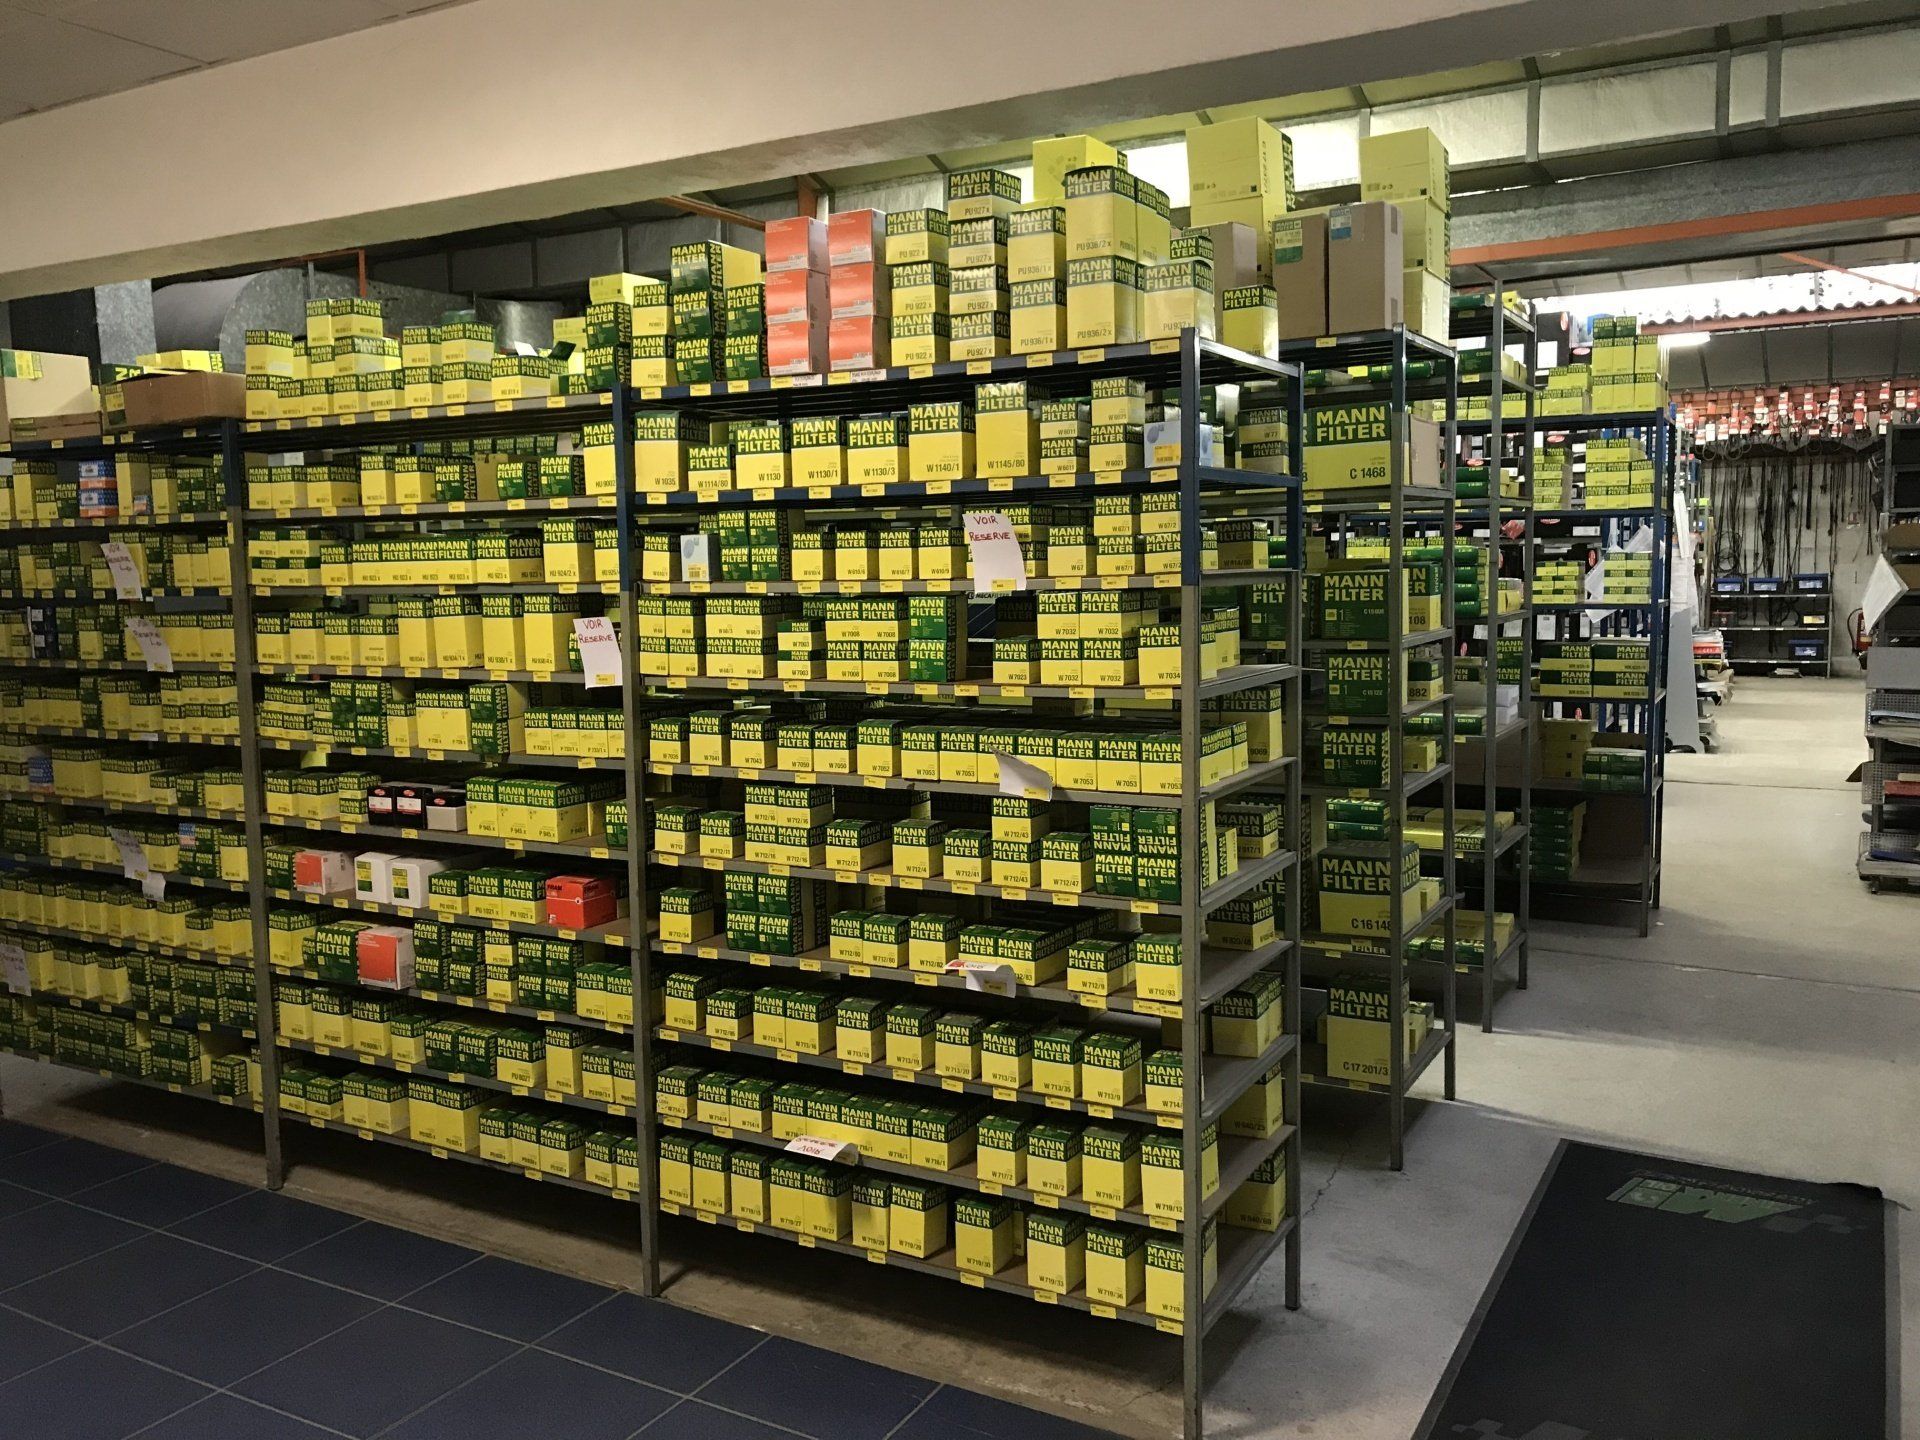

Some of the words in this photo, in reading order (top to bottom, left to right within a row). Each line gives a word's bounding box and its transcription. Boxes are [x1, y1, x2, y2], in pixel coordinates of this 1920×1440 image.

[952, 172, 990, 186] MANN
[1068, 170, 1111, 185] MANN
[952, 184, 990, 197] FILTER
[1068, 181, 1111, 196] FILTER
[672, 244, 706, 257] MANN
[672, 254, 706, 265] FILTER
[1069, 259, 1112, 274] MANN
[1146, 265, 1192, 279] MANN
[1069, 270, 1112, 284] FILTER
[1012, 282, 1054, 295] MANN
[1146, 276, 1192, 292] FILTER
[1224, 288, 1260, 299] MANN
[1012, 293, 1054, 306] FILTER
[1224, 296, 1260, 308] FILTER
[893, 316, 932, 328] MANN
[952, 314, 992, 328] MANN
[893, 324, 932, 336] FILTER
[952, 325, 992, 339] FILTER
[676, 339, 709, 351] MANN
[676, 348, 709, 360] FILTER
[978, 386, 1024, 398] MANN
[978, 398, 1024, 410] FILTER
[911, 406, 958, 419] MANN
[1316, 407, 1384, 426] MANN
[637, 418, 676, 428] MANN
[793, 421, 836, 432] MANN
[850, 422, 894, 433] MANN
[911, 418, 958, 431] FILTER
[637, 428, 676, 439] FILTER
[738, 428, 780, 440] MANN
[1317, 422, 1385, 442] FILTER
[793, 432, 836, 445] FILTER
[850, 433, 894, 446] FILTER
[738, 440, 780, 452] FILTER
[690, 447, 727, 457] MANN
[690, 457, 727, 468] FILTER
[1142, 494, 1176, 504] MANN
[1142, 502, 1176, 511] FILTER
[974, 516, 998, 524] VOIR
[544, 522, 574, 532] MANN
[1050, 528, 1084, 537] MANN
[544, 532, 574, 542] FILTER
[970, 532, 1010, 541] RESERVE
[1050, 535, 1084, 545] FILTER
[1324, 575, 1384, 587] MANN
[1039, 594, 1076, 603] MANN
[1324, 588, 1384, 601] FILTER
[910, 600, 943, 608] MANN
[1040, 603, 1076, 612] FILTER
[910, 608, 944, 616] FILTER
[583, 619, 603, 630] VOIR
[1140, 627, 1179, 636] MANN
[578, 634, 614, 644] RESERVE
[1140, 636, 1179, 646] FILTER
[1084, 640, 1120, 650] MANN
[1084, 649, 1120, 658] FILTER
[1329, 658, 1382, 668] MANN
[1329, 670, 1382, 680] FILTER
[690, 716, 718, 726] MANN
[690, 724, 718, 733] FILTER
[902, 732, 934, 742] MANN
[902, 740, 934, 750] FILTER
[1058, 738, 1093, 749] MANN
[1100, 740, 1136, 752] MANN
[1058, 748, 1093, 759] FILTER
[1100, 749, 1136, 760] FILTER
[467, 783, 493, 792] MANN
[467, 792, 493, 801] FILTER
[994, 798, 1028, 807] MANN
[994, 806, 1028, 816] FILTER
[894, 826, 926, 836] MANN
[894, 836, 926, 845] FILTER
[945, 838, 978, 848] MANN
[945, 846, 978, 856] FILTER
[1043, 842, 1078, 852] MANN
[1043, 850, 1078, 860] FILTER
[1096, 855, 1132, 864] MANN
[1096, 864, 1132, 874] FILTER
[1322, 859, 1391, 874] MANN
[1323, 876, 1390, 891] FILTER
[1137, 944, 1173, 954] MANN
[1137, 953, 1174, 964] FILTER
[1330, 988, 1388, 1006] MANN
[1330, 1002, 1388, 1018] FILTER
[498, 1038, 528, 1049] MANN
[1034, 1040, 1070, 1052] MANN
[498, 1047, 528, 1060] FILTER
[1034, 1050, 1070, 1062] FILTER
[978, 1127, 1012, 1140] MANN
[979, 1136, 1012, 1150] FILTER
[1142, 1145, 1179, 1158] MANN
[1142, 1154, 1180, 1168] FILTER
